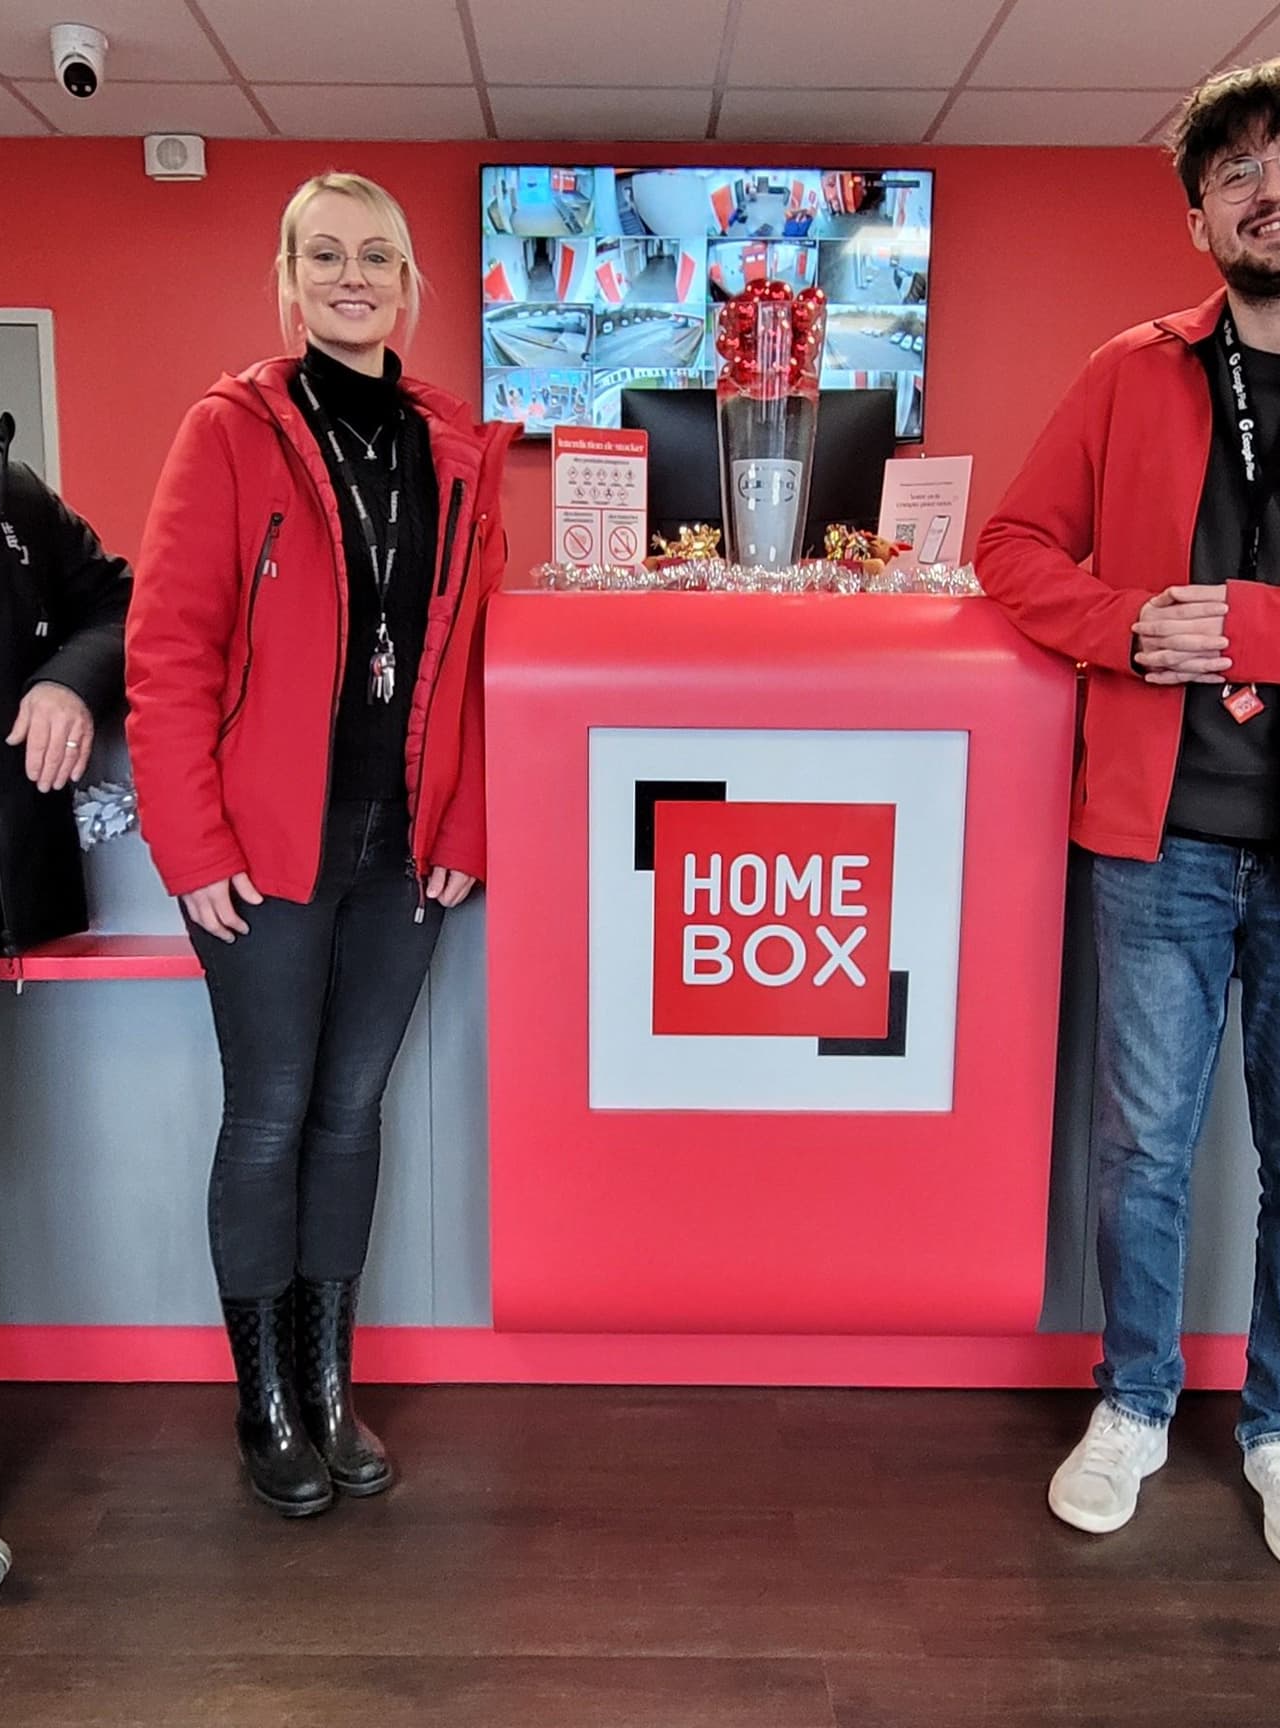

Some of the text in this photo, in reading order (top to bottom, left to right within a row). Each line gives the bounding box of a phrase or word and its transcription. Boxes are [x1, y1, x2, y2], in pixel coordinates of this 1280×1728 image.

[1232, 366, 1246, 393] Google
[558, 438, 604, 449] Interdiction
[615, 443, 644, 452] stocker
[1241, 432, 1255, 462] Google
[683, 852, 870, 917] HOME
[682, 924, 868, 987] BOX
